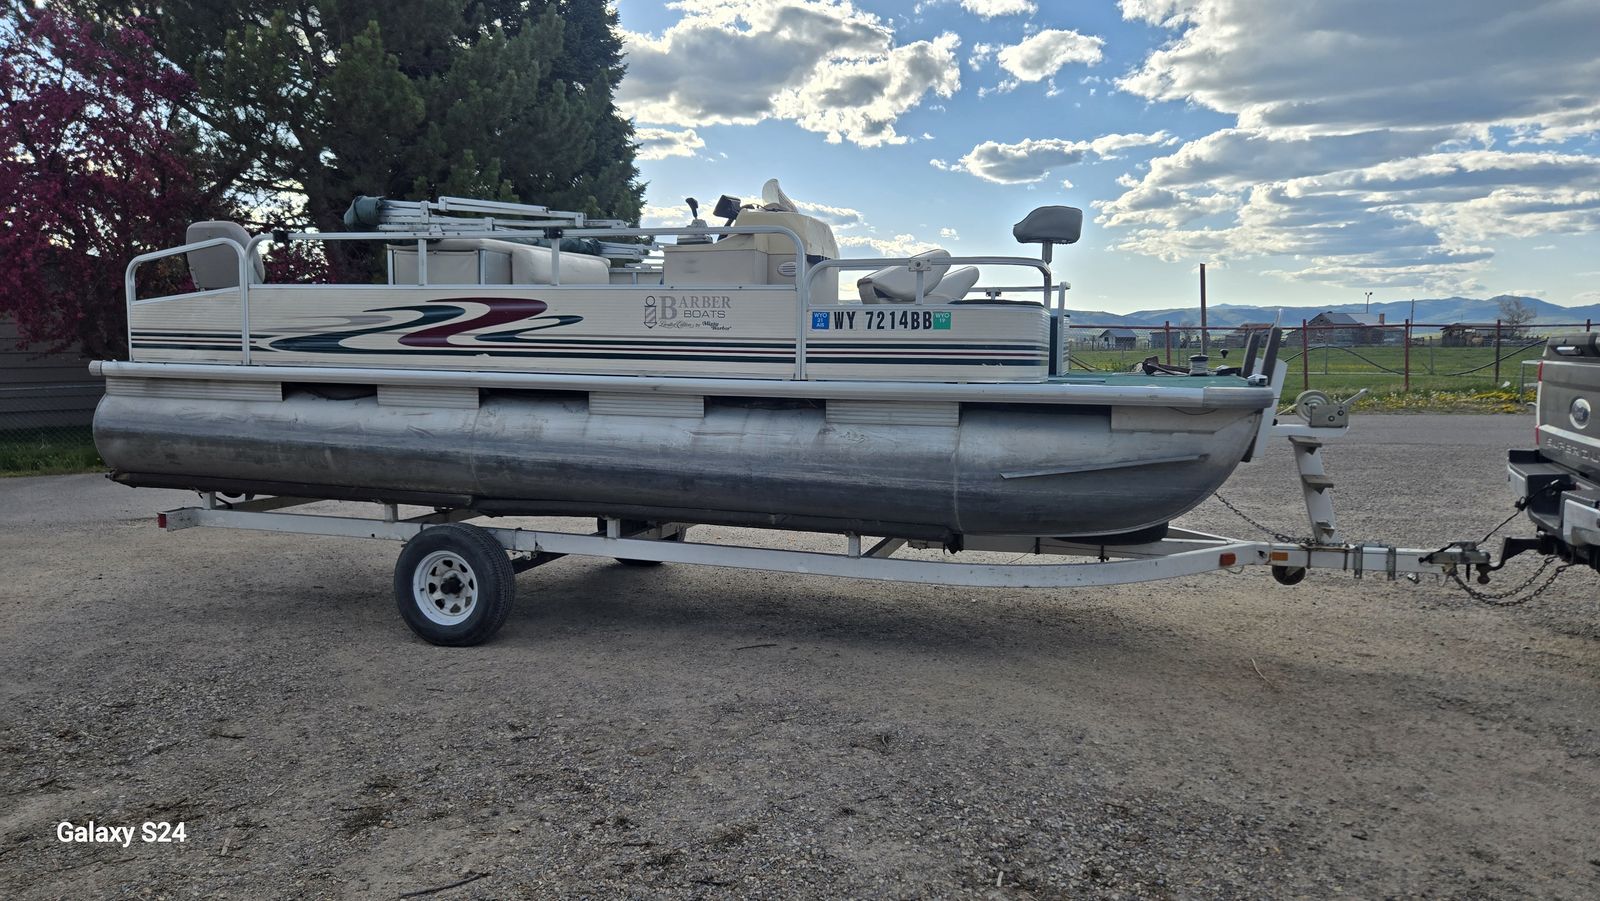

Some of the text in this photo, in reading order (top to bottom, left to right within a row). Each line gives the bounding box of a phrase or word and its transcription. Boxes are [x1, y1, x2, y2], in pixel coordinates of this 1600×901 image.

[659, 295, 731, 320] BARBER
[684, 310, 725, 318] BOATS
[833, 311, 932, 330] WY 7214BB
[1546, 438, 1600, 463] SUPER DU
